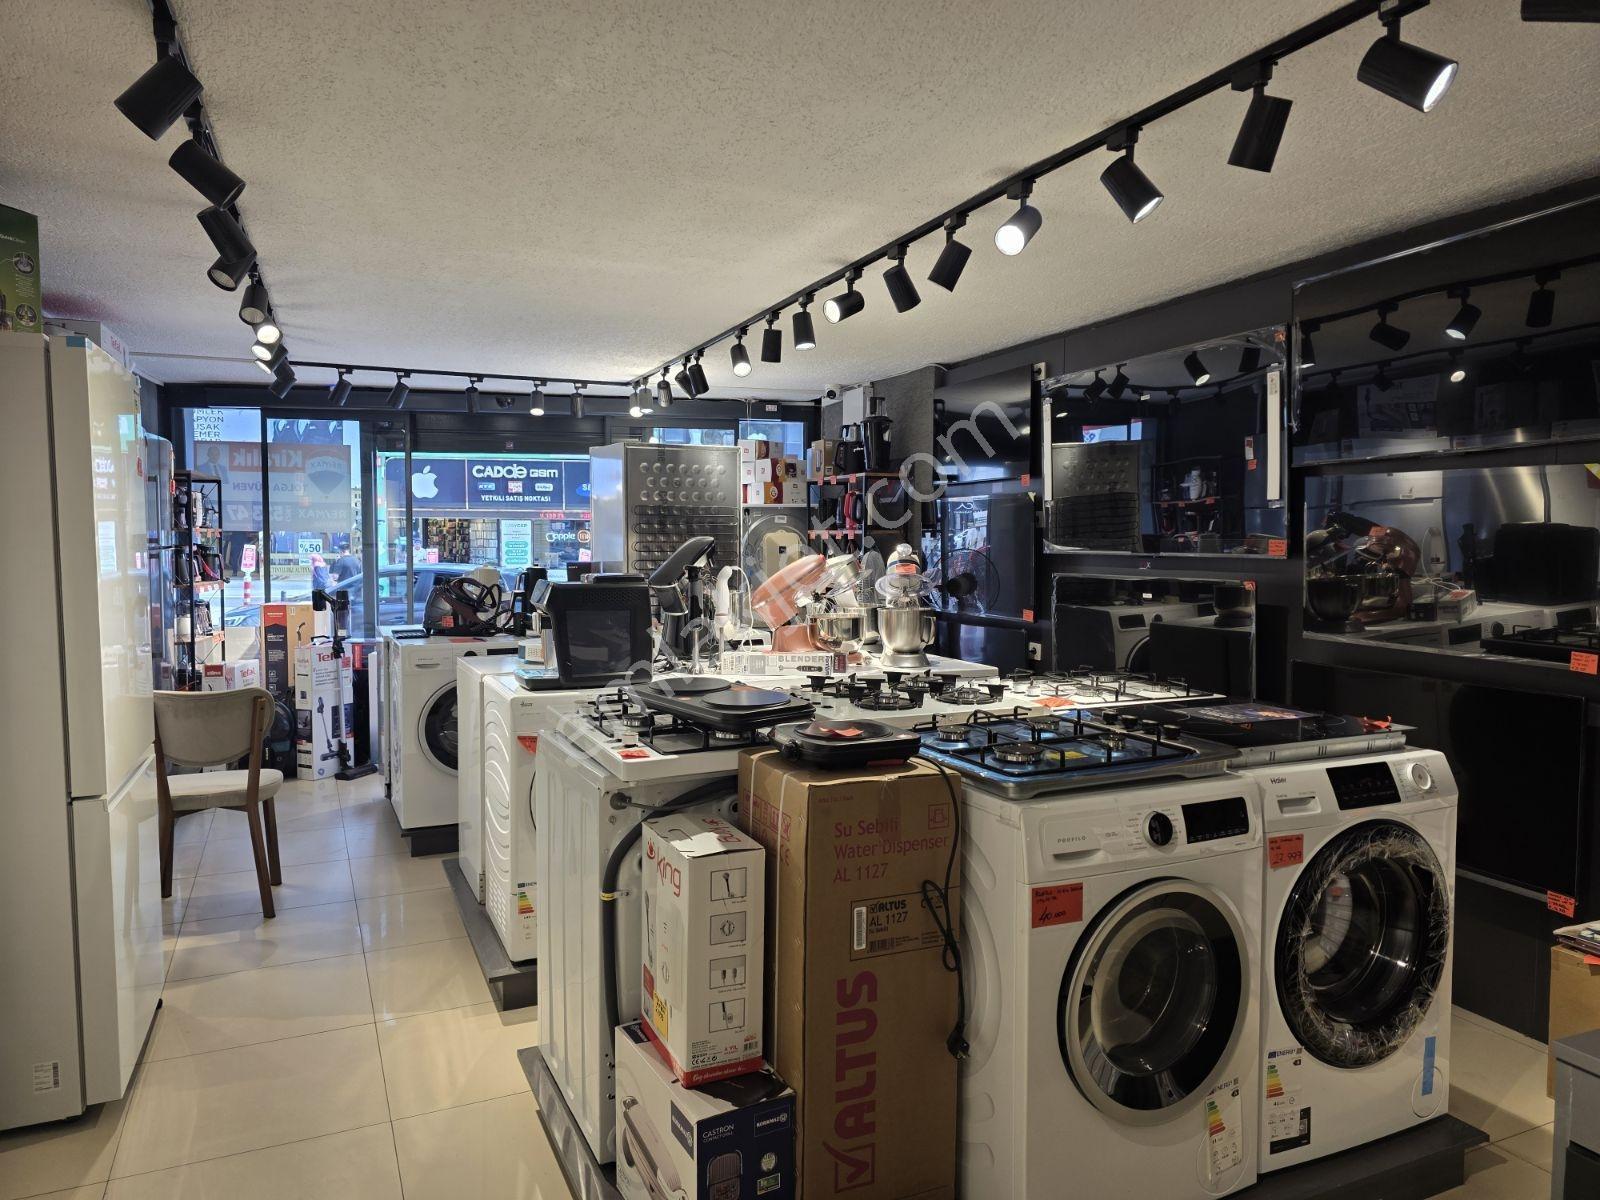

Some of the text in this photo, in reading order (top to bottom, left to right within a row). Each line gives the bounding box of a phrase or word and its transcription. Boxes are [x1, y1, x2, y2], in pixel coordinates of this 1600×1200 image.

[299, 543, 321, 553] %50
[777, 655, 825, 663] BLENDER
[834, 817, 899, 838] Su Sebili
[834, 836, 948, 860] Water Dispenser
[656, 845, 682, 898] king
[833, 862, 889, 884] AL 1127
[878, 900, 907, 912] ALTUS
[869, 911, 908, 927] AL 1127
[833, 970, 879, 1140] ALTUS
